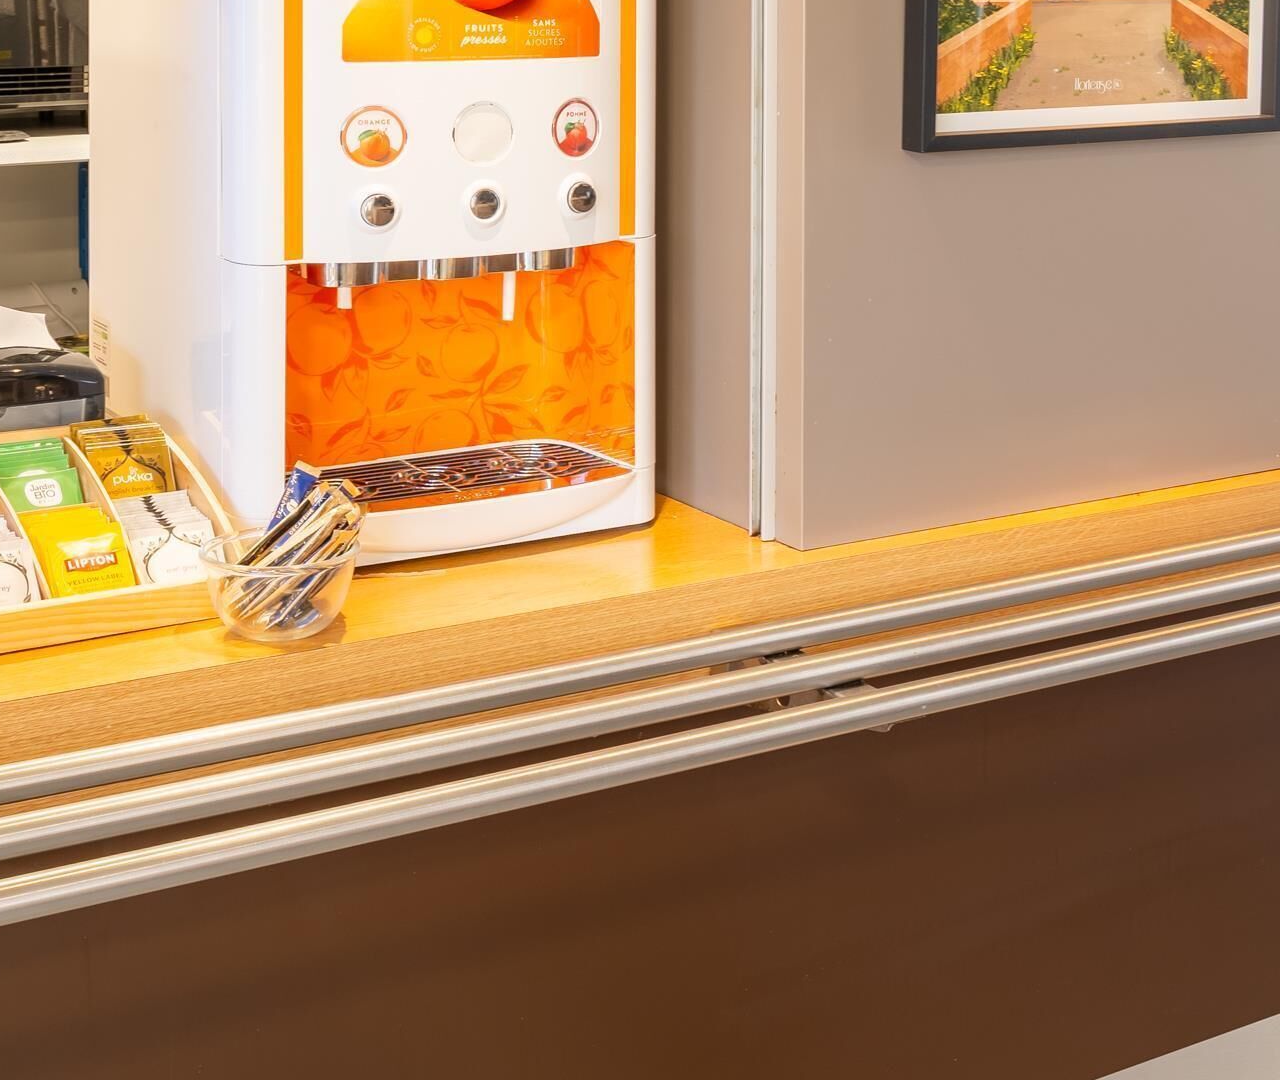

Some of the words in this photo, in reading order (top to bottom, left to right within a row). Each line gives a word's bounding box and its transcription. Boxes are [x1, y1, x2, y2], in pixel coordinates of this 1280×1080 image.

[532, 19, 557, 27] SANS
[465, 24, 504, 33] FRUITS
[527, 28, 561, 37] SUCRES
[566, 110, 587, 118] POMME
[358, 118, 391, 126] ORANGE
[112, 471, 153, 487] pukka
[29, 483, 56, 492] Jardin
[67, 553, 115, 571] LIPTON
